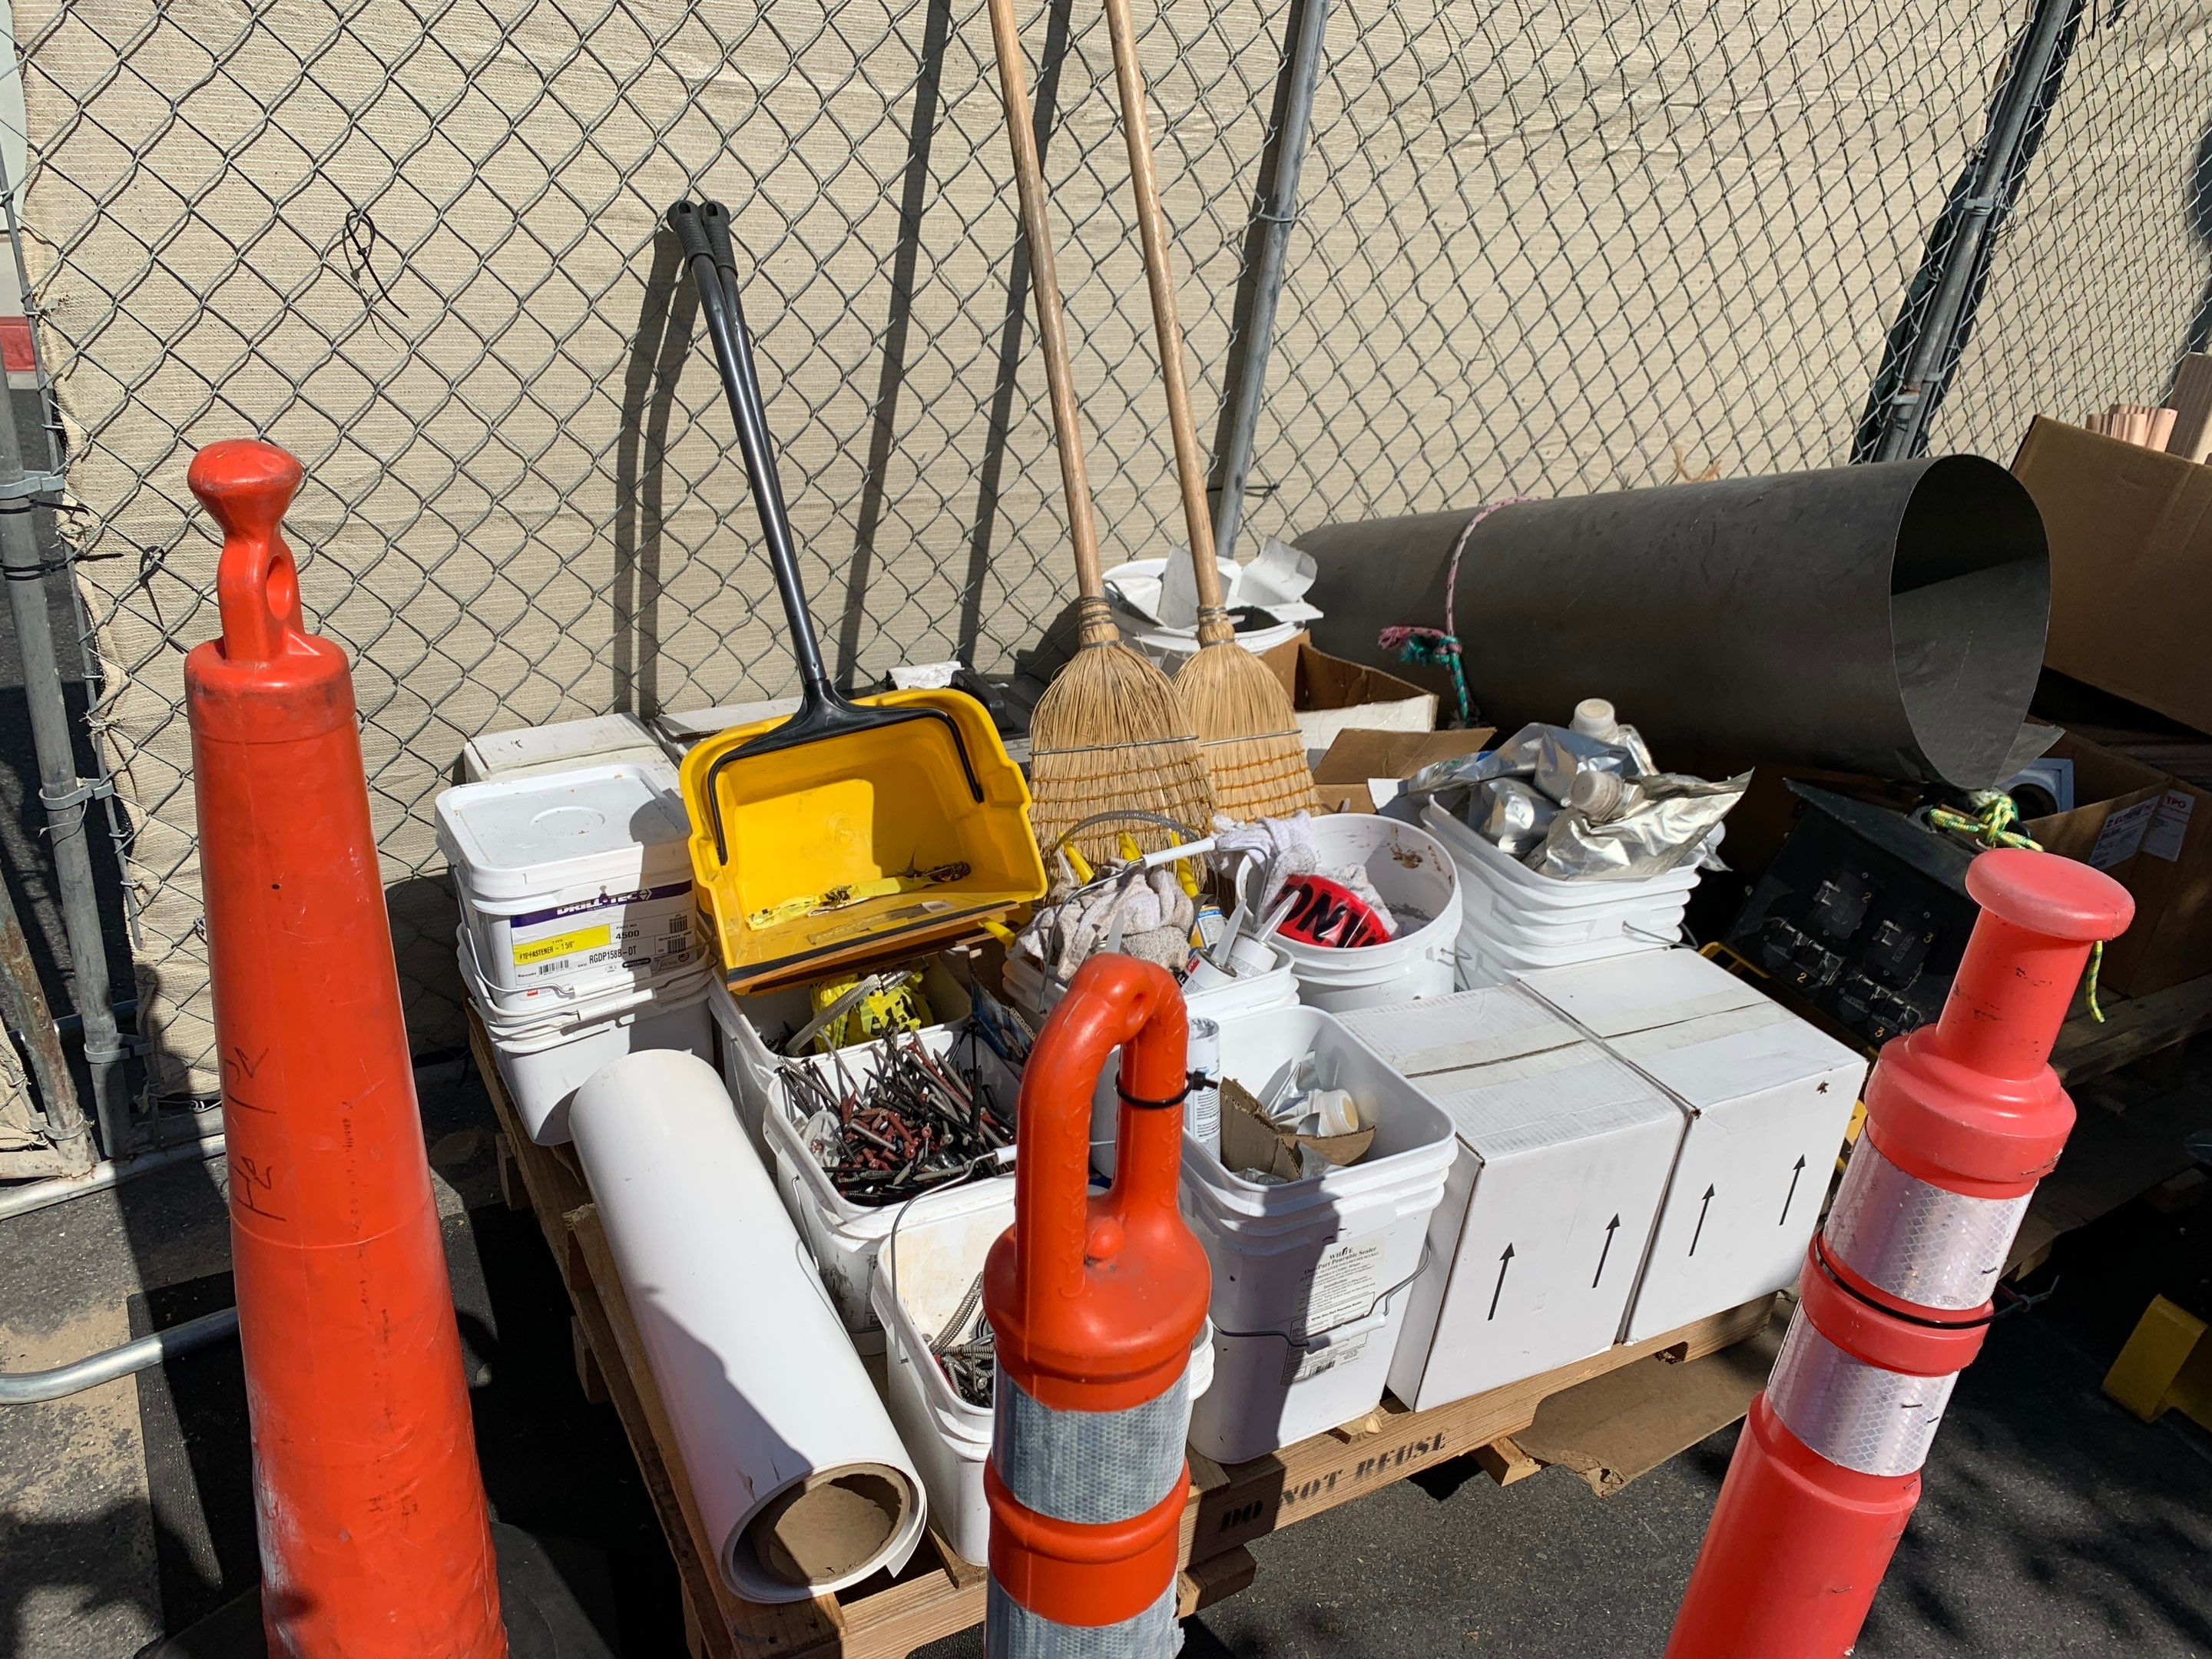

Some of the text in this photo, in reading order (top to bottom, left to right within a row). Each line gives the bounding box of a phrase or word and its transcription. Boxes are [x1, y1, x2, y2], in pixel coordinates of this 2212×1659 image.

[2167, 796, 2187, 809] TPO
[1861, 891, 1873, 903] 2
[615, 930, 640, 940] 4500
[1923, 932, 1936, 945] 3
[1796, 972, 1807, 984] 2
[1332, 1253, 1358, 1264] Pourable
[1359, 1247, 1377, 1255] Sealer
[1219, 1432, 1446, 1532] DO NOT REUSE
